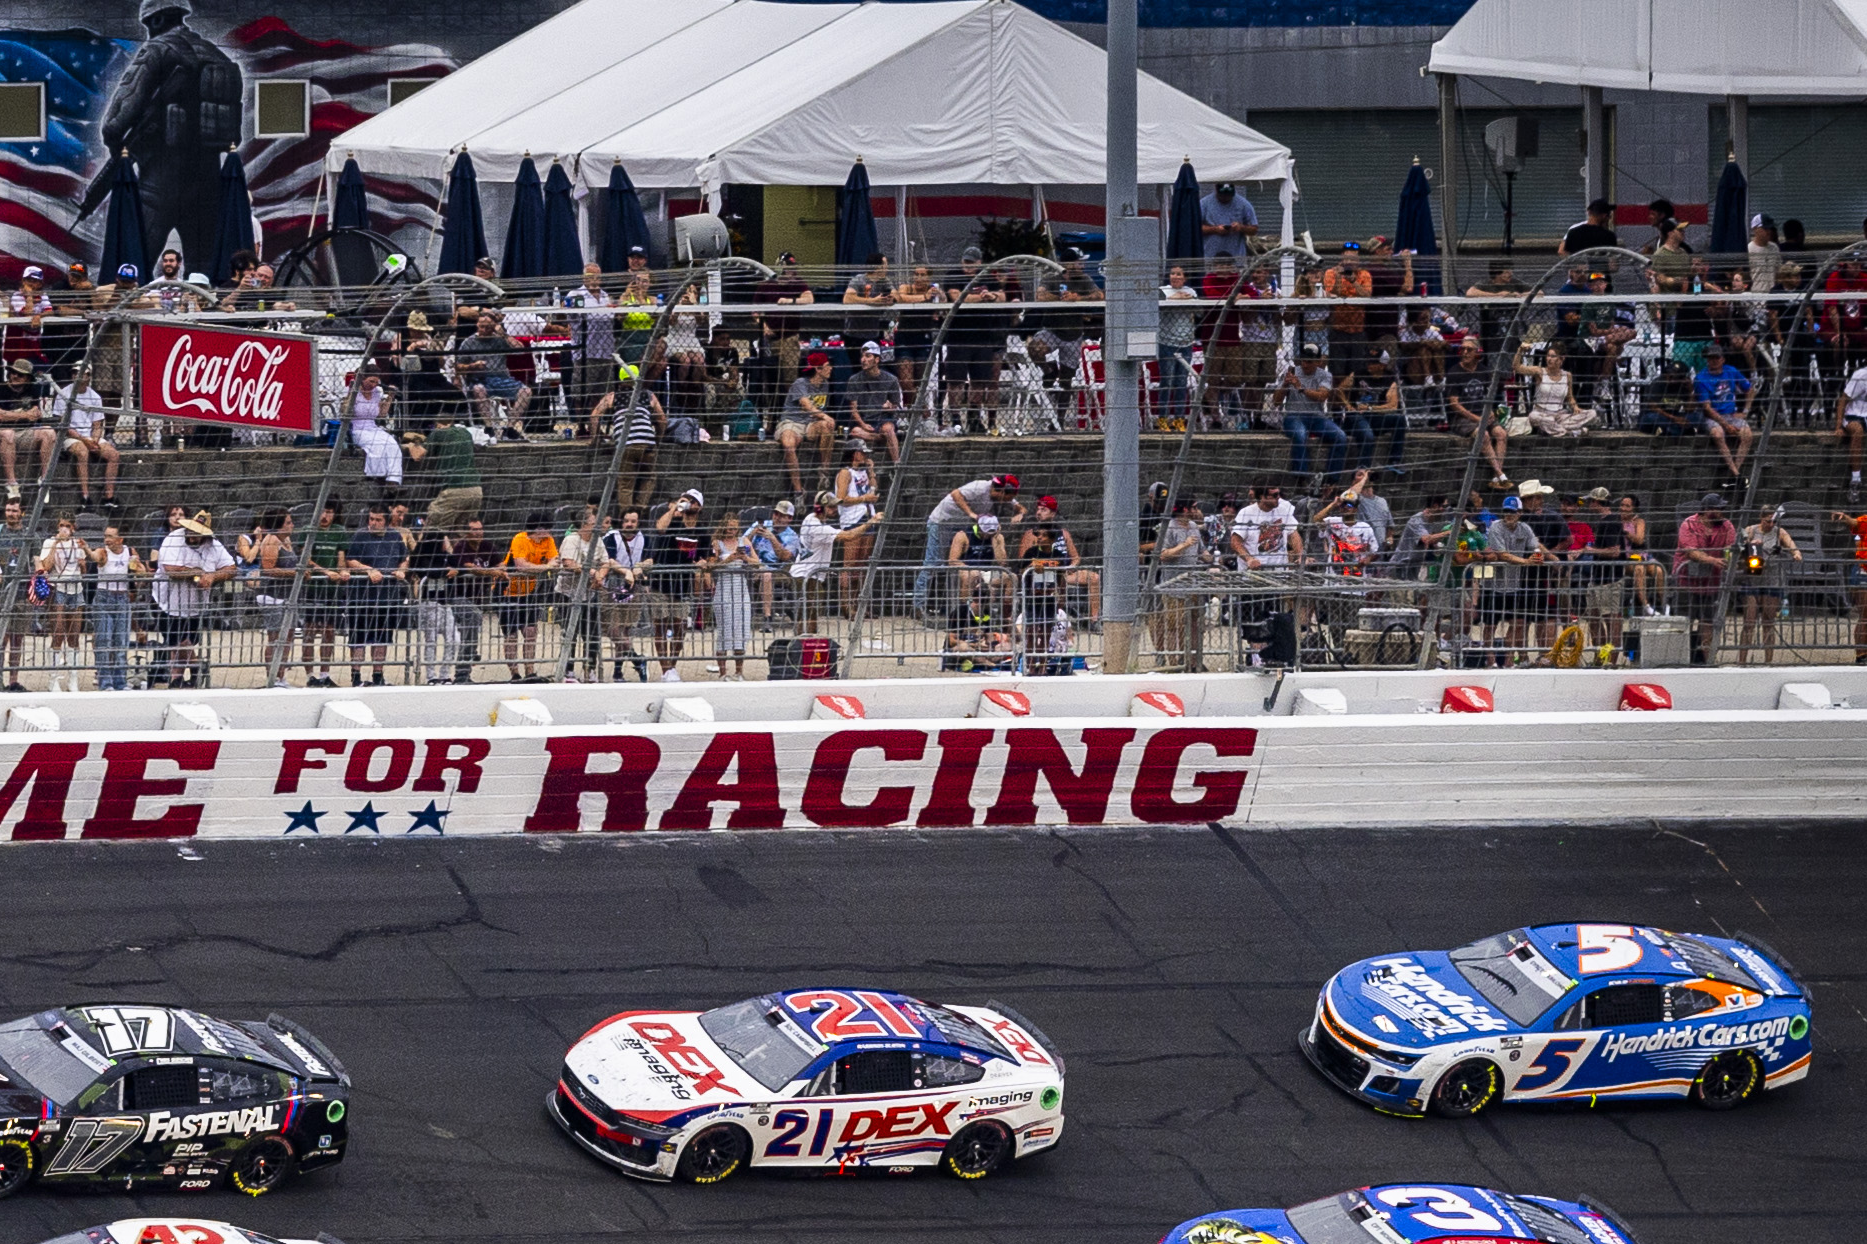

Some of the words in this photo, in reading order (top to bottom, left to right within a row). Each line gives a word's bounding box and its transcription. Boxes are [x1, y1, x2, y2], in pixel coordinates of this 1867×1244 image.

[162, 334, 291, 421] Coca-Cola
[274, 738, 491, 793] FOR
[524, 727, 1258, 832] RACING
[1577, 923, 1644, 974] 5
[82, 1006, 176, 1057] 17
[783, 989, 923, 1042] 21
[627, 1022, 744, 1098] DEX
[1512, 1038, 1587, 1092] 5
[838, 1101, 961, 1143] DEX
[968, 1089, 1033, 1108] imaging
[44, 1117, 146, 1176] 17
[143, 1106, 281, 1143] FASTENAL
[763, 1108, 834, 1157] 21
[1378, 1187, 1503, 1231] 3
